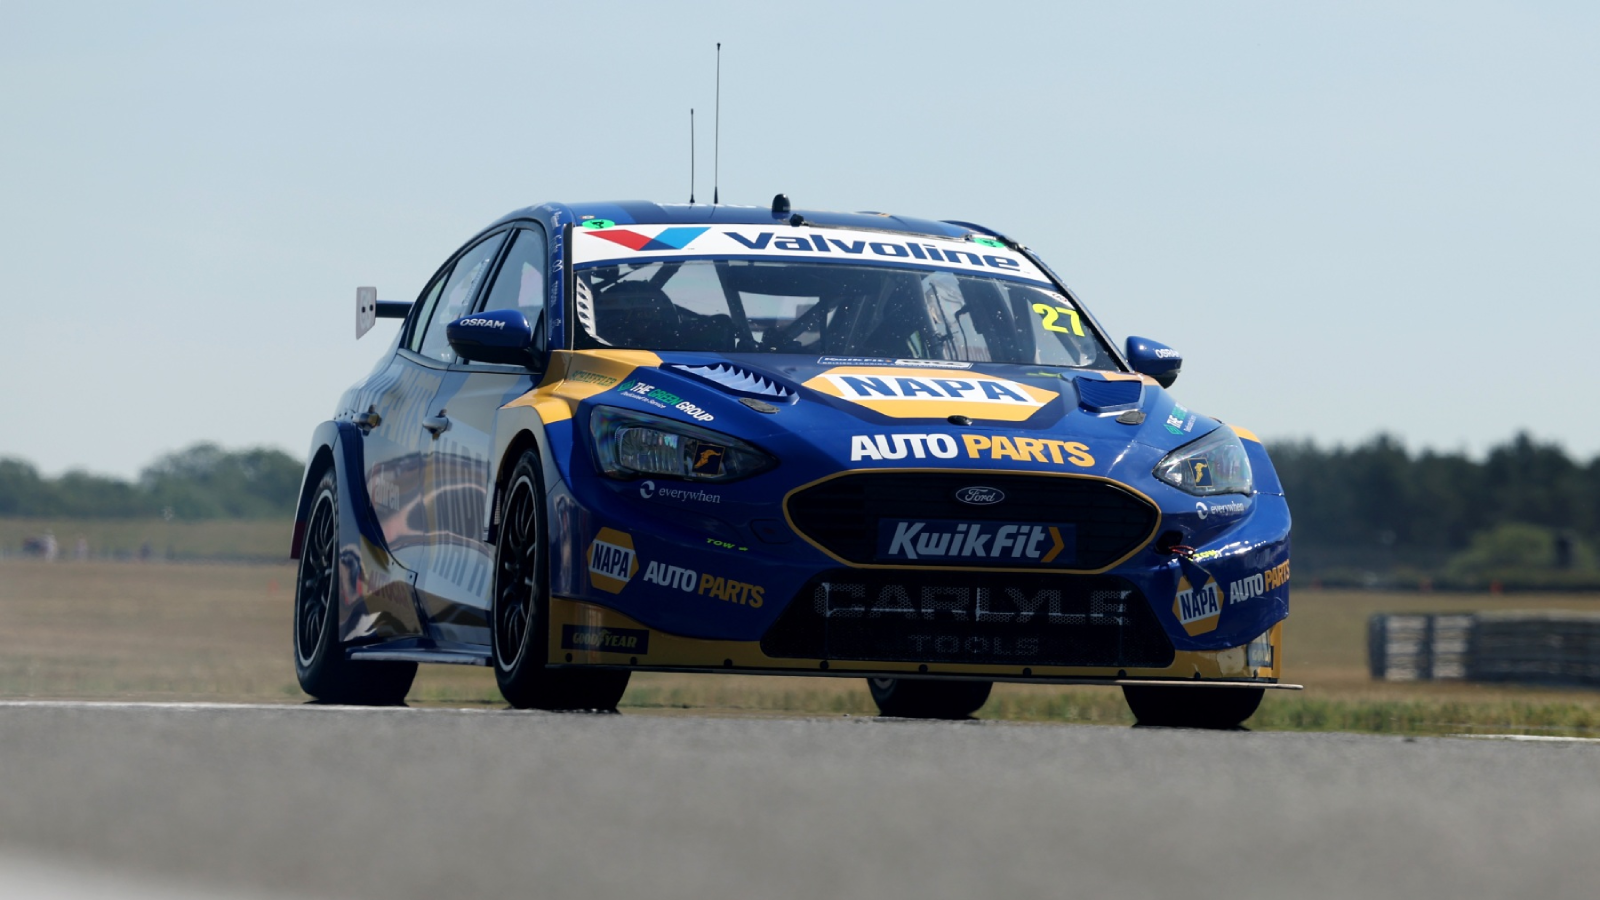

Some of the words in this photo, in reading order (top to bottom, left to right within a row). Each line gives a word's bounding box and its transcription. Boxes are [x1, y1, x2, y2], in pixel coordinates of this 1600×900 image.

[721, 231, 1021, 271] Valvoline
[459, 318, 506, 330] OSRAM
[1032, 302, 1086, 338] 27
[630, 381, 655, 395] THE
[648, 388, 684, 406] GREEN
[675, 401, 715, 422] GROUP
[840, 376, 1030, 402] NAPA
[851, 433, 958, 461] AUTO
[961, 434, 1096, 467] PARTS
[658, 486, 721, 504] everywhen
[964, 488, 996, 502] Ford
[1210, 501, 1245, 515] everywhen
[592, 542, 630, 578] NAPA
[706, 537, 735, 549] TOW
[643, 560, 697, 592] AUTO
[698, 573, 766, 608] PARTS
[1230, 573, 1264, 604] AUTO
[1264, 558, 1291, 592] PARTS
[813, 582, 1132, 626] CARLYLE
[1180, 586, 1218, 620] NAPA
[572, 631, 638, 648] GOODYEAR
[907, 634, 1039, 656] TOOLS
